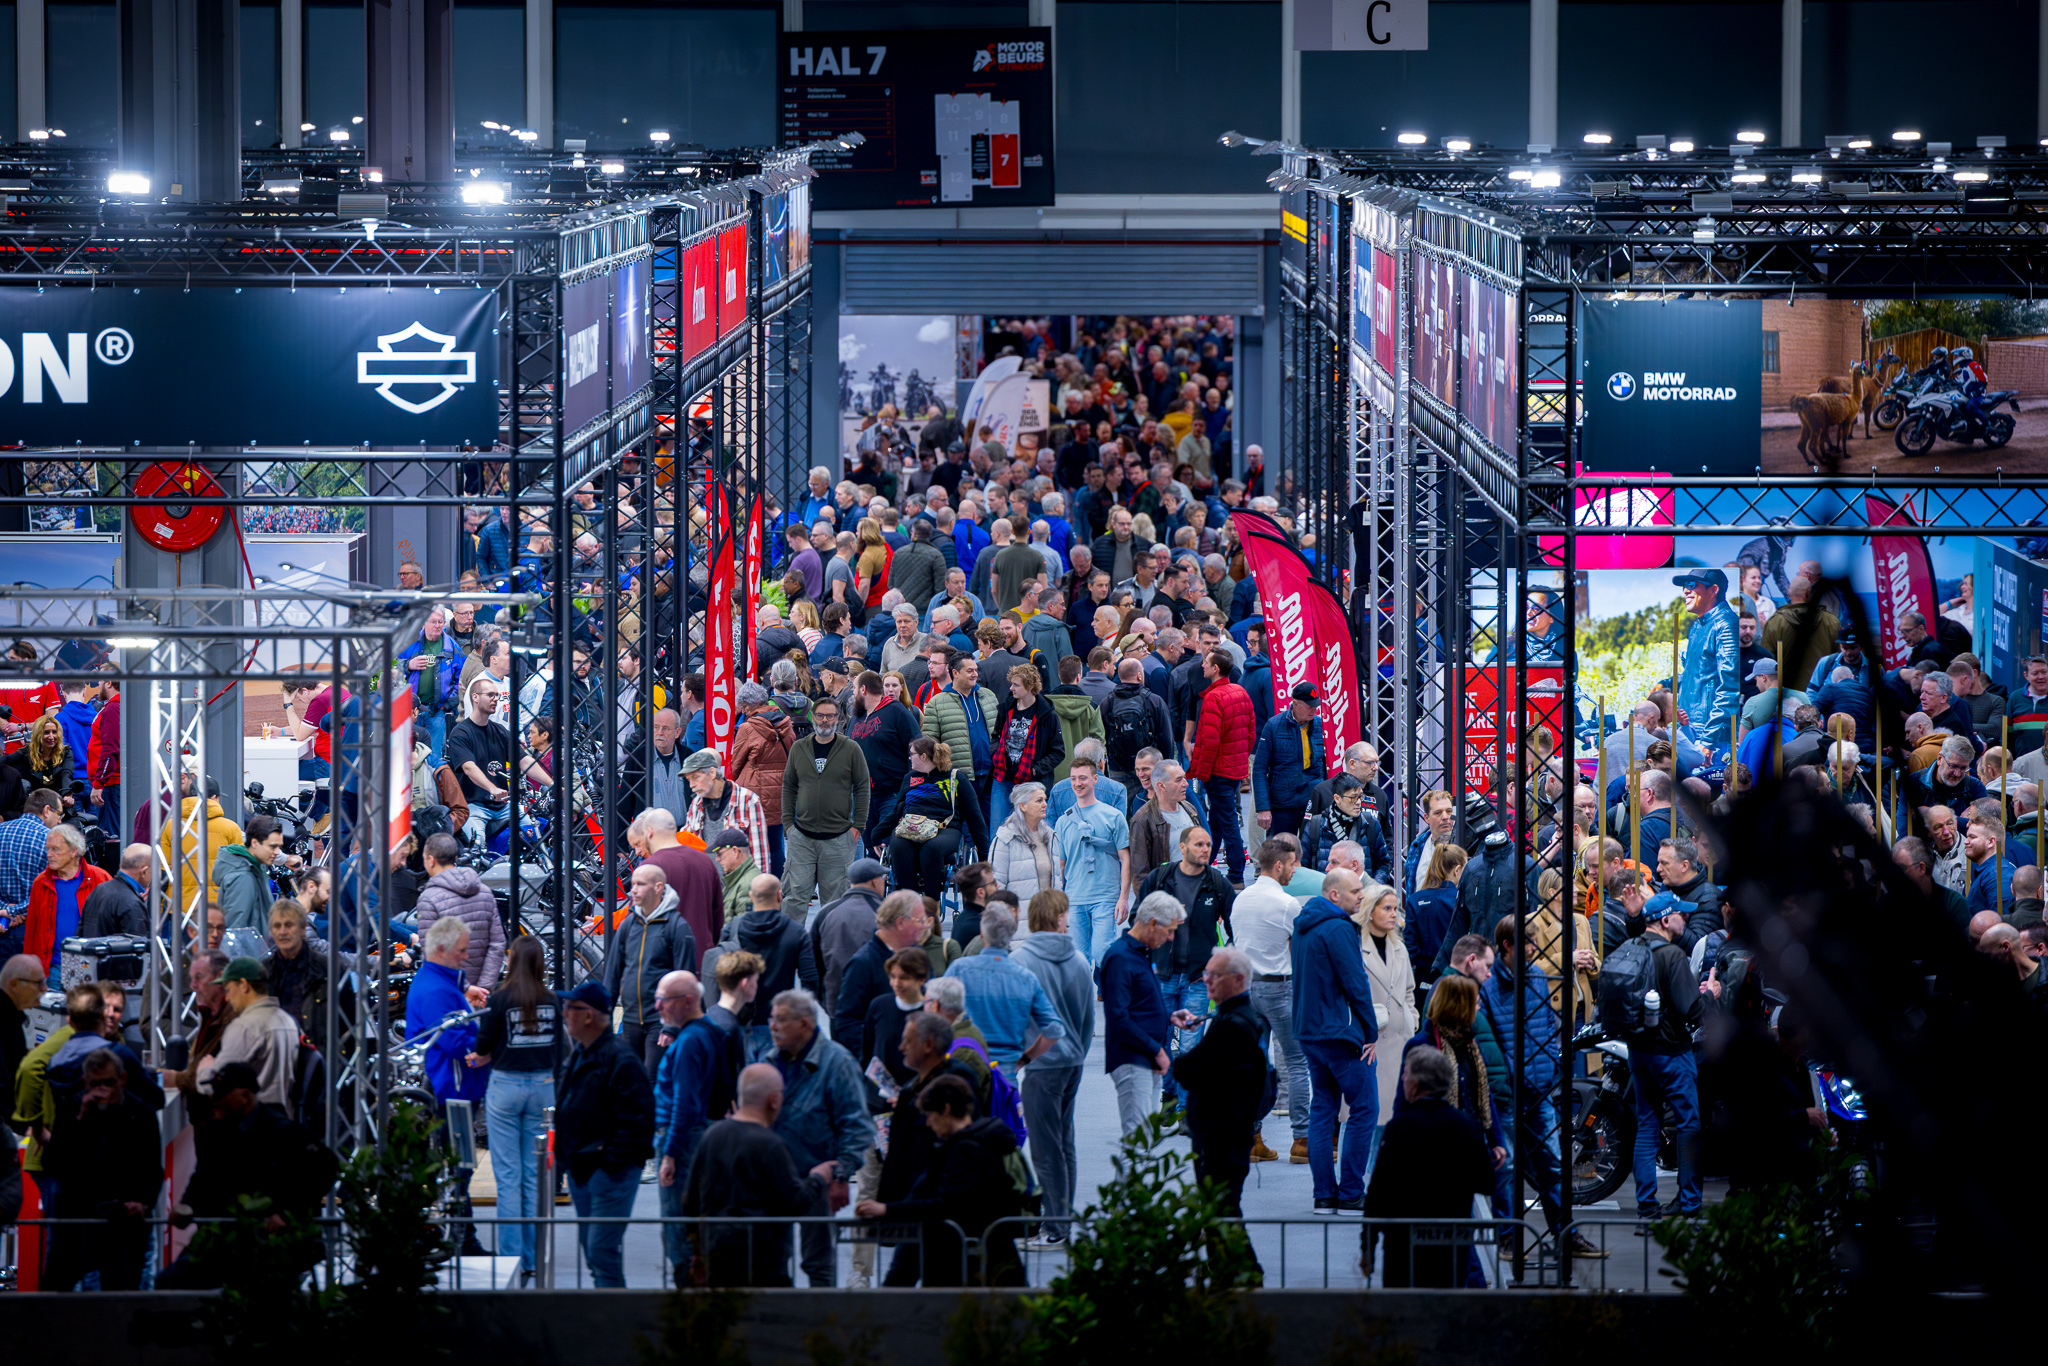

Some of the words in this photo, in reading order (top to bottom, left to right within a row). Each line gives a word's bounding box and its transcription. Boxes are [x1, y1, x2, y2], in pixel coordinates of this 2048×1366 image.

[1366, 0, 1391, 45] C
[997, 41, 1045, 53] MOTOR
[790, 46, 861, 76] HAL
[866, 46, 887, 76] 7
[997, 52, 1045, 63] BEURS
[997, 62, 1044, 71] UTRECHT
[945, 103, 960, 114] 10
[975, 110, 983, 120] 9
[1000, 113, 1008, 124] 8
[948, 131, 958, 142] 11
[1000, 154, 1010, 167] 7
[950, 172, 964, 183] 12
[1643, 372, 1686, 386] BMW
[1643, 387, 1737, 401] MOTORRAD
[1594, 503, 1629, 513] Inian
[1466, 711, 1496, 729] ARE
[1465, 744, 1477, 756] UIL
[1465, 764, 1495, 777] ATTO
